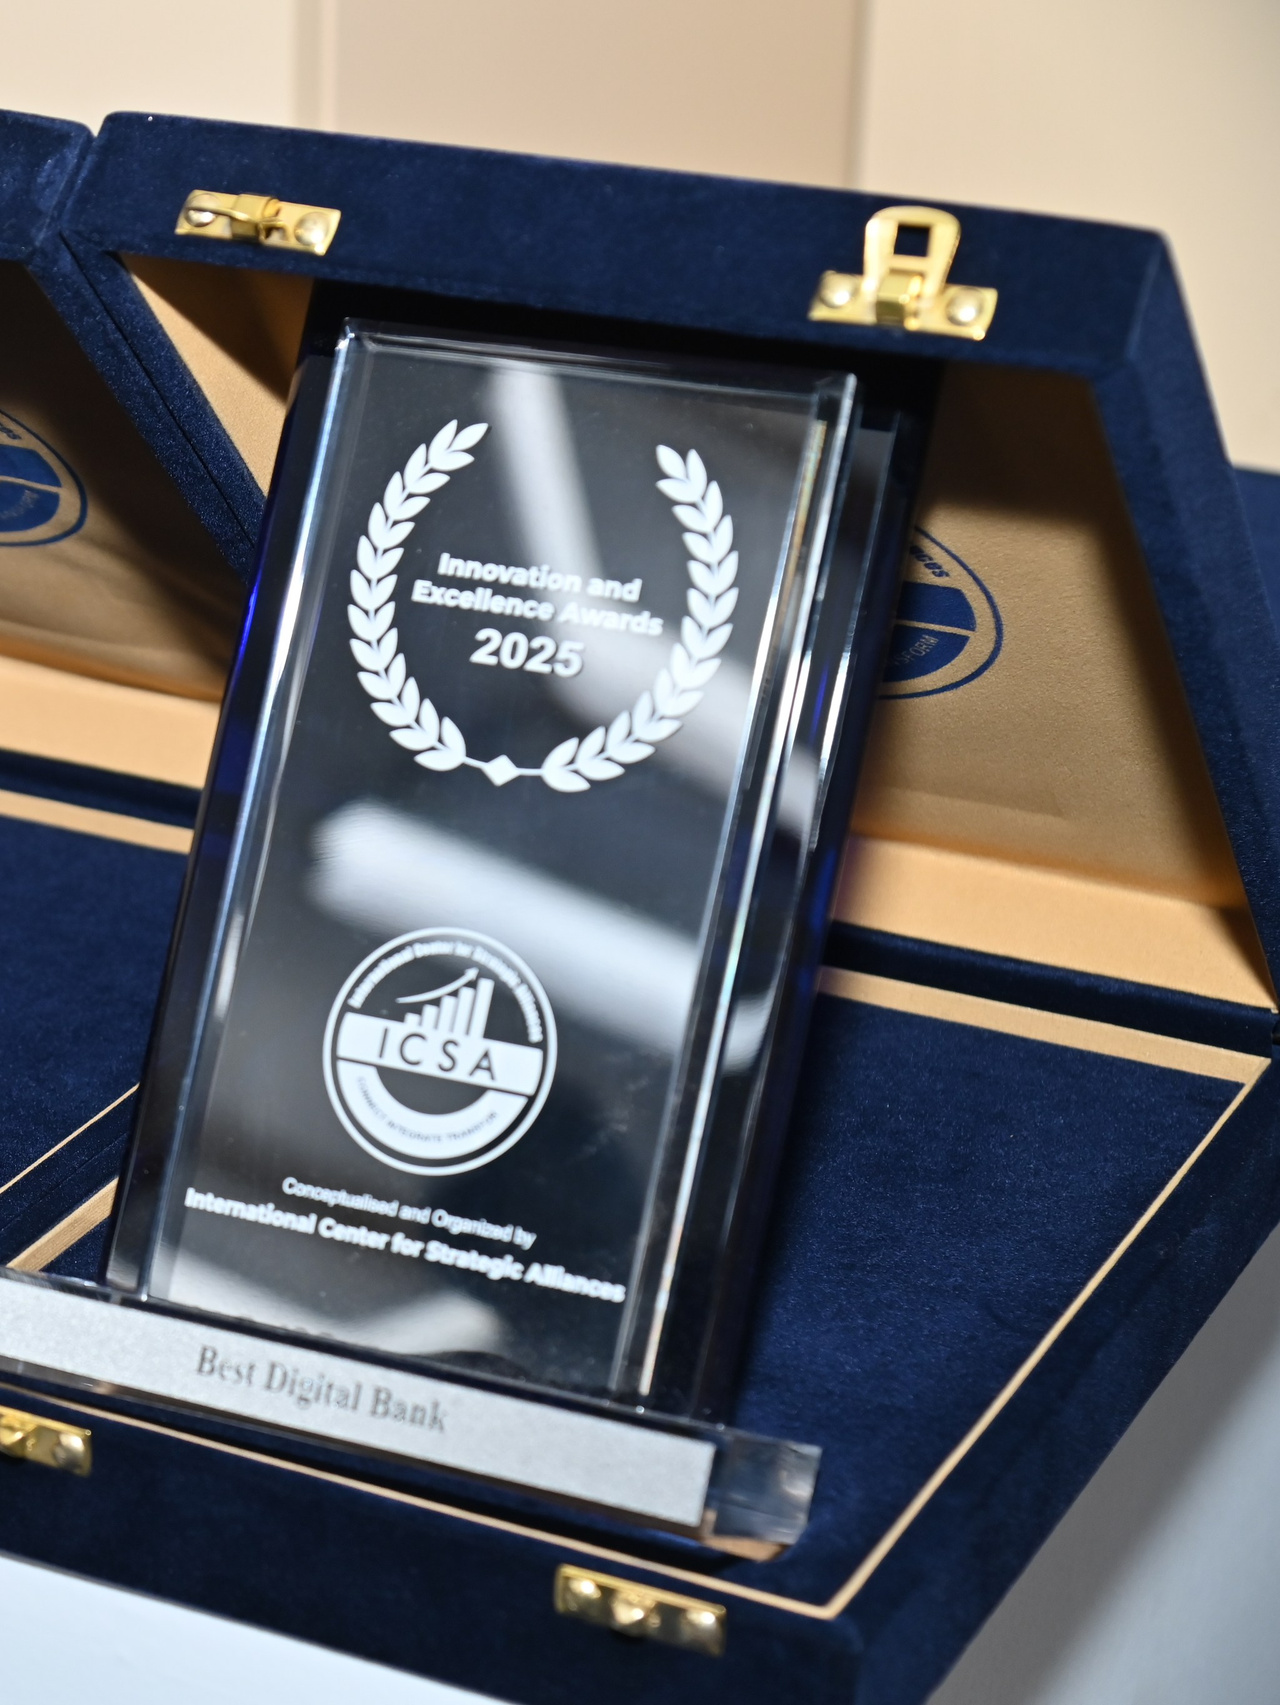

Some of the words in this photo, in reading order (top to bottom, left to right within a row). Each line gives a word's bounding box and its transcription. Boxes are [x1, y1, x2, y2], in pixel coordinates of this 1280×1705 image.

[437, 552, 583, 595] Innovation
[586, 578, 643, 603] and
[410, 579, 555, 621] Excellence
[556, 602, 664, 637] Awards
[469, 627, 585, 678] 2025
[378, 1027, 496, 1081] ICSA
[184, 1187, 316, 1235] International
[318, 1215, 389, 1251] Center
[390, 1232, 425, 1259] for
[424, 1239, 525, 1281] Strategic
[524, 1261, 626, 1302] Alliances
[398, 1204, 432, 1225] and
[431, 1208, 513, 1243] Organized
[513, 1225, 537, 1251] by
[196, 1345, 255, 1385] Best
[264, 1362, 363, 1412] Digital
[369, 1385, 448, 1432] Bank
